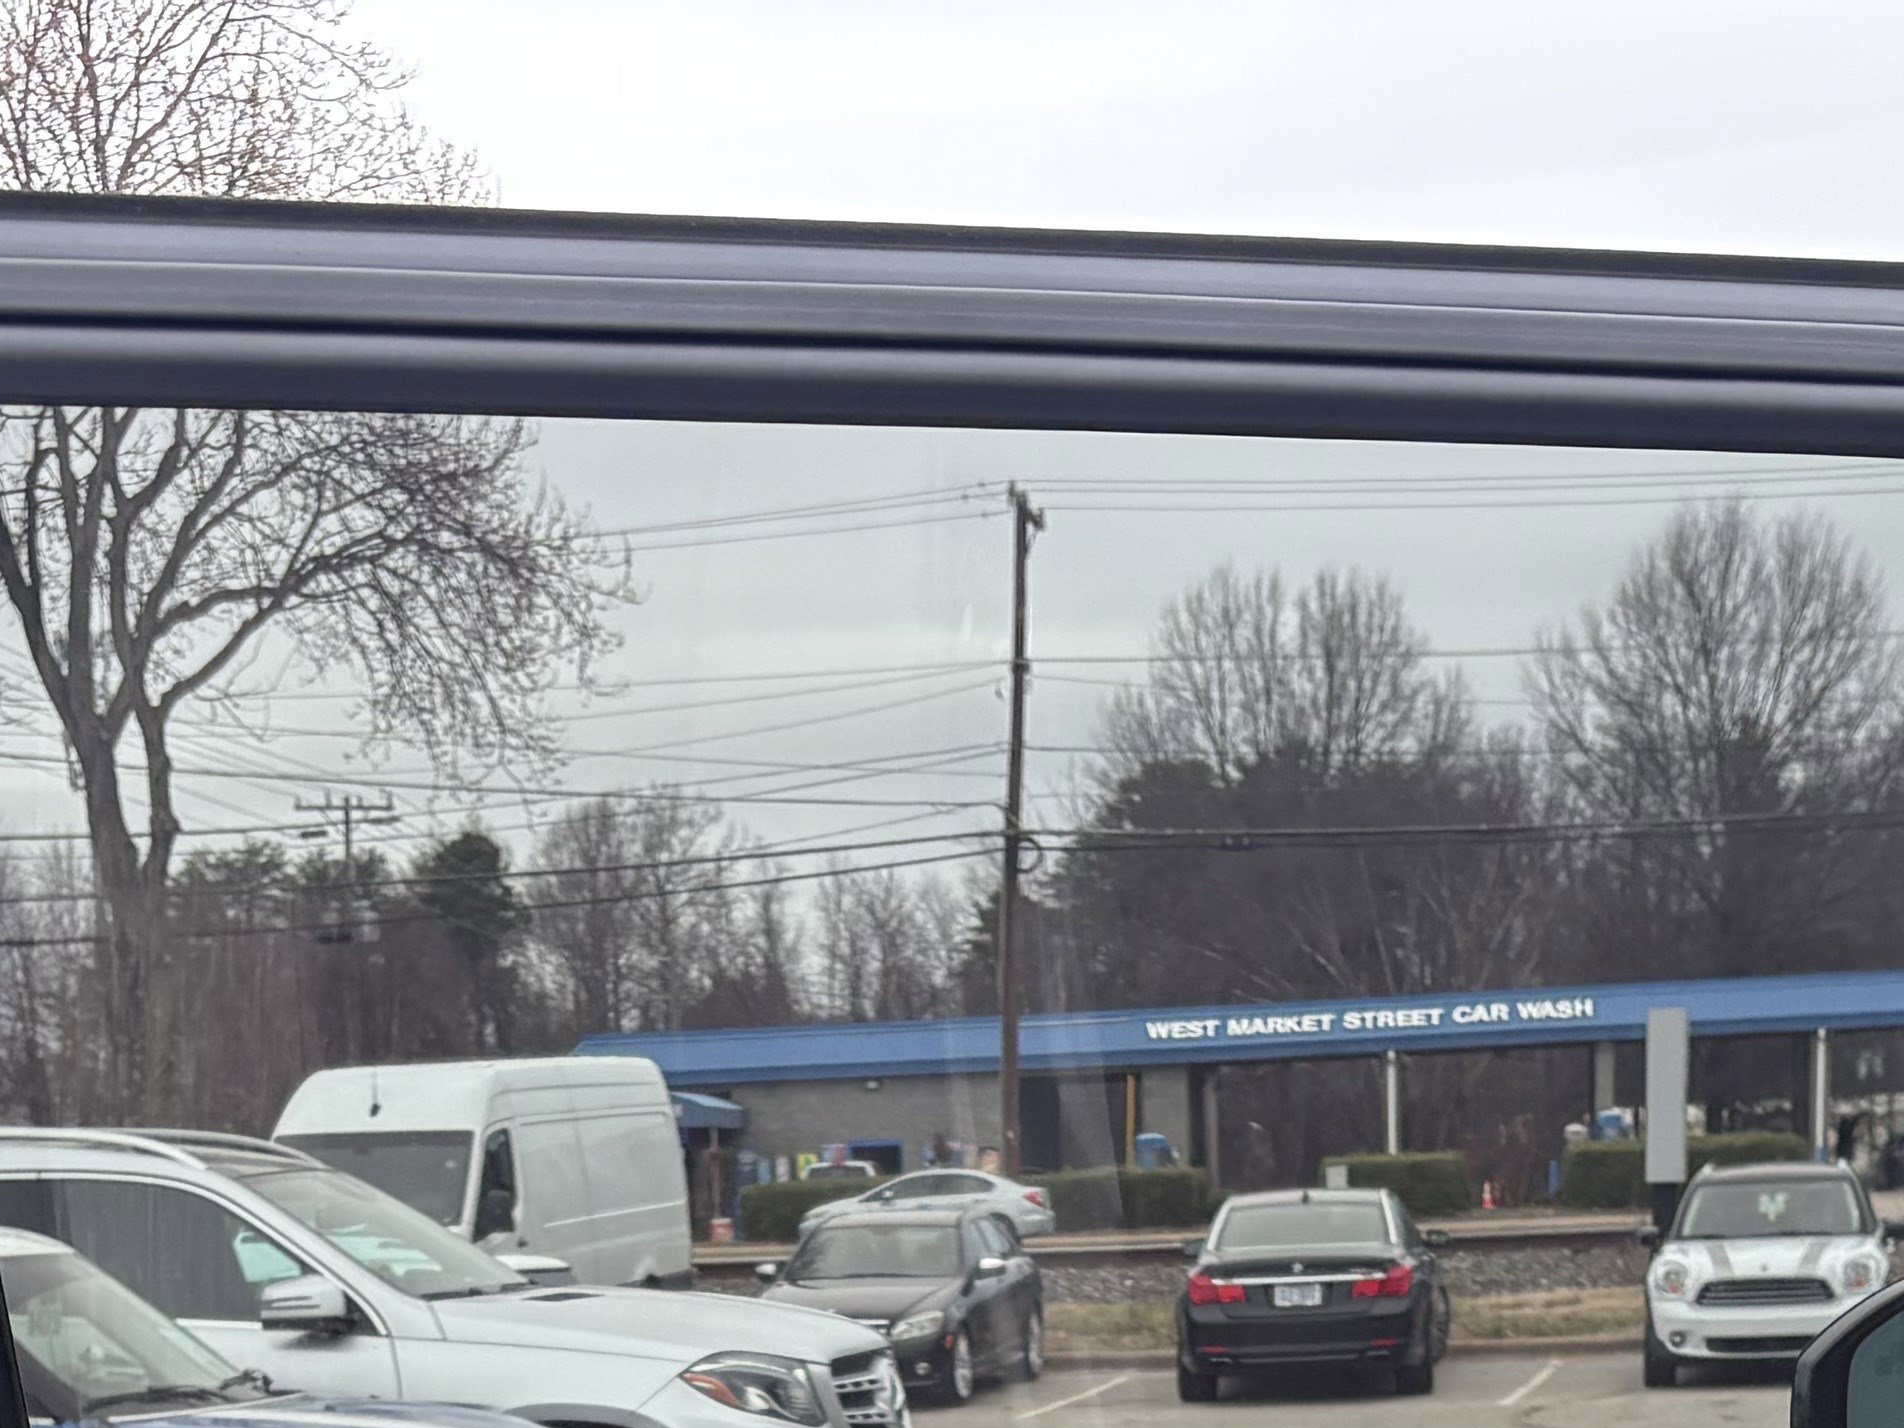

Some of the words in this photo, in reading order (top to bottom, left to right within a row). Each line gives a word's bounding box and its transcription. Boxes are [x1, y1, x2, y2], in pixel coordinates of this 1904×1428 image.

[1146, 1019, 1219, 1040] WEST
[1227, 1014, 1336, 1037] MARKET
[1342, 1007, 1445, 1030] STREET
[1452, 1002, 1510, 1024] CAR
[1517, 997, 1595, 1020] WASH
